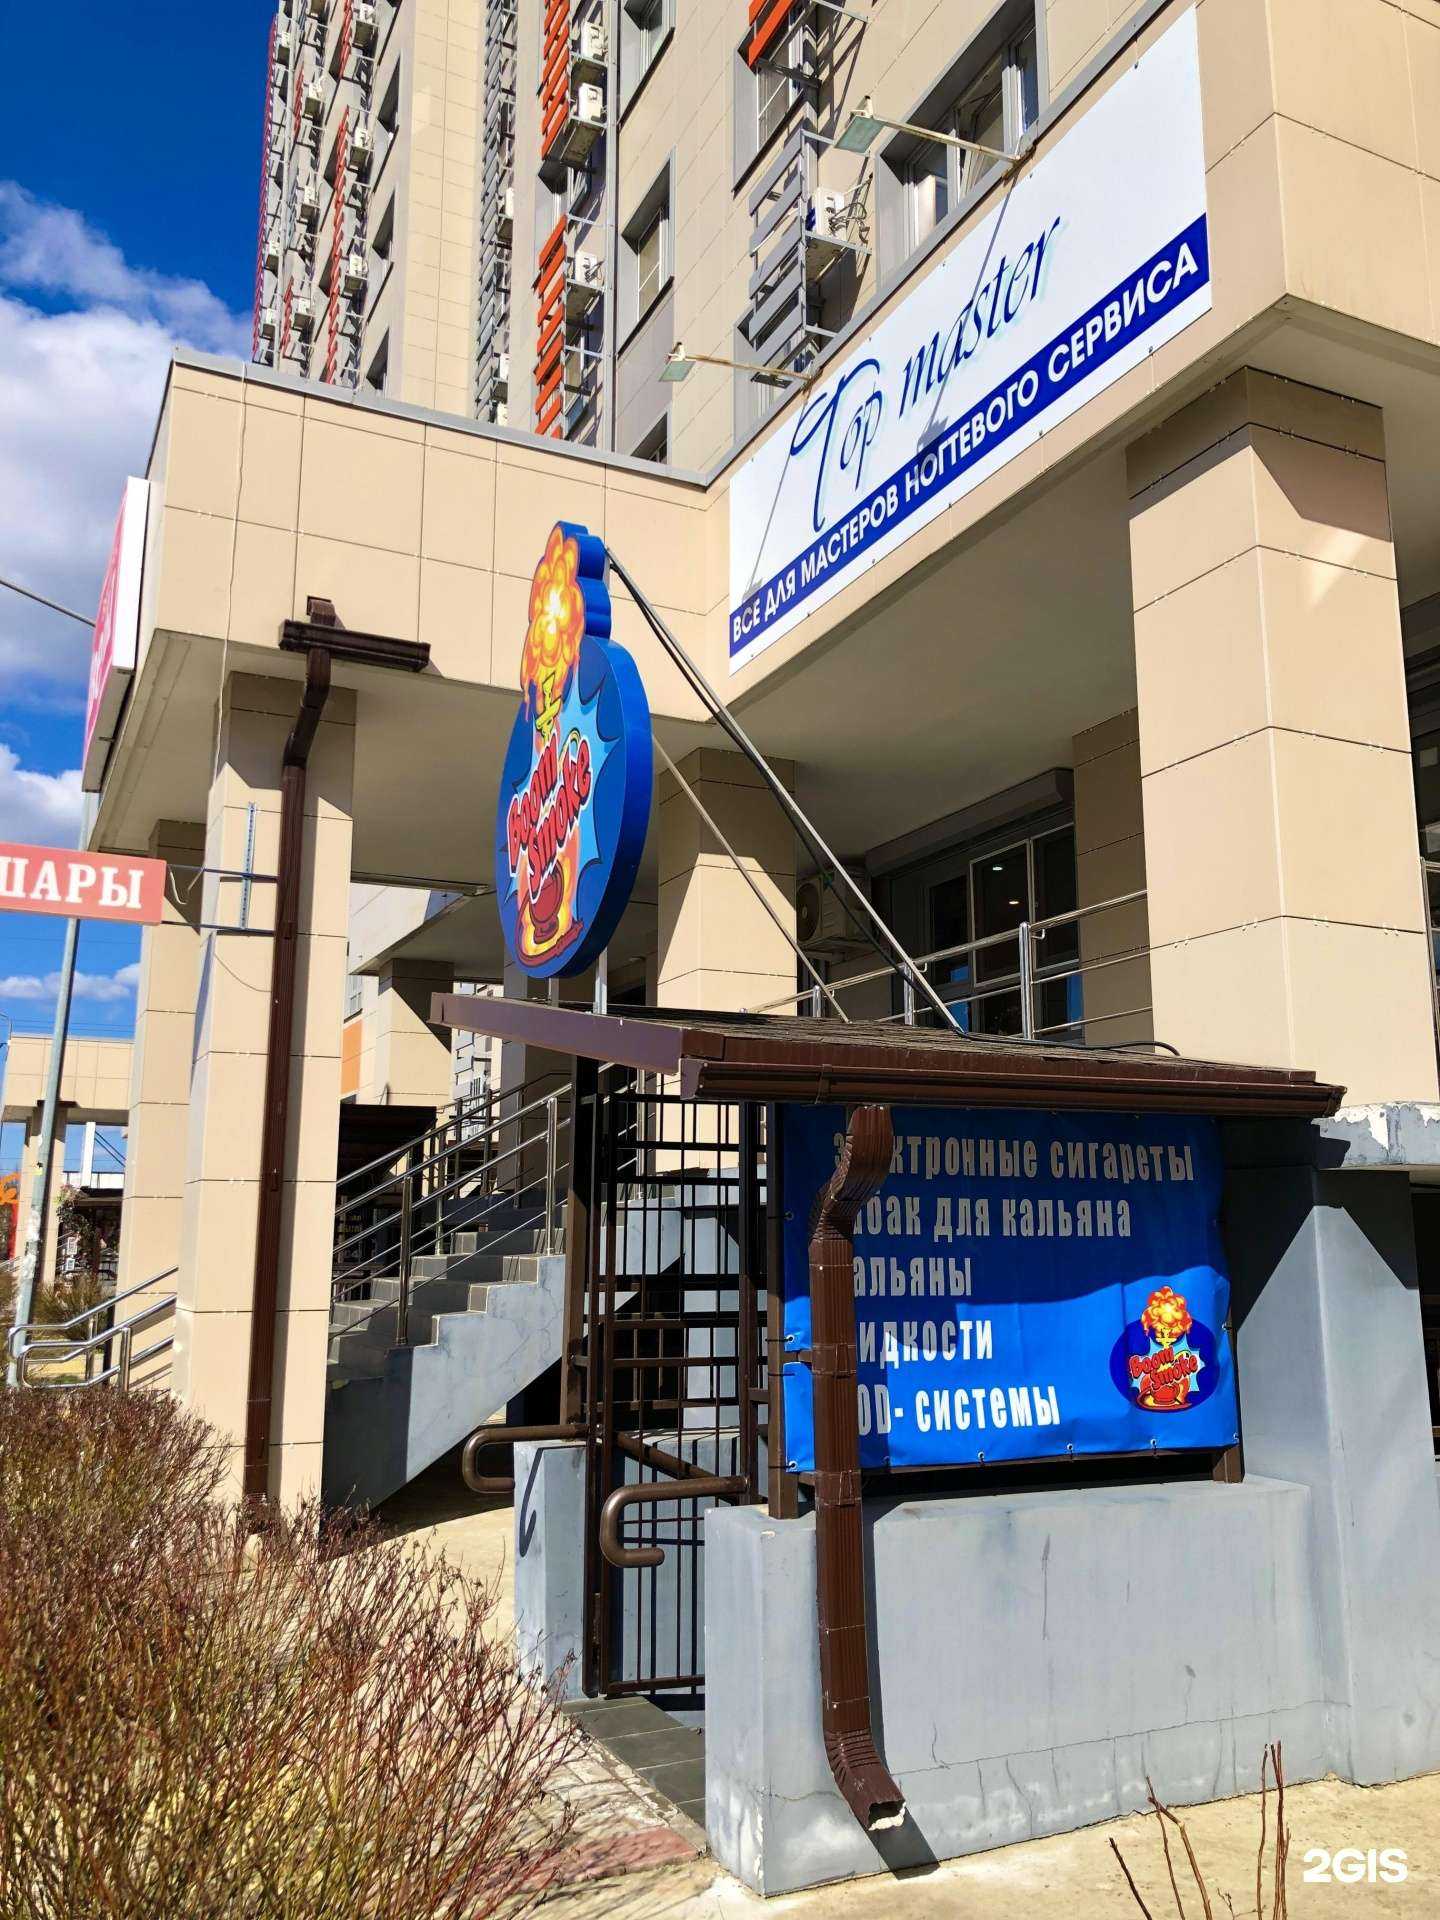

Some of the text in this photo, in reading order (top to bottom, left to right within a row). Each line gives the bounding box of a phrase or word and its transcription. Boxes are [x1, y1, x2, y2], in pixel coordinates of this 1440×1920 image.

[790, 216, 1061, 532] Top master
[733, 242, 1198, 644] ВСЕ ДЛЯ МАСТЕРОВ НОГТЕВОГО СЕРВИСА
[508, 731, 558, 875] Boom
[1050, 1140, 1194, 1184] сигареты
[933, 1197, 990, 1242] для
[1002, 1199, 1131, 1237] кальяна
[853, 1256, 972, 1298] альяны
[859, 1320, 993, 1369] идкости
[914, 1385, 1061, 1432] системы
